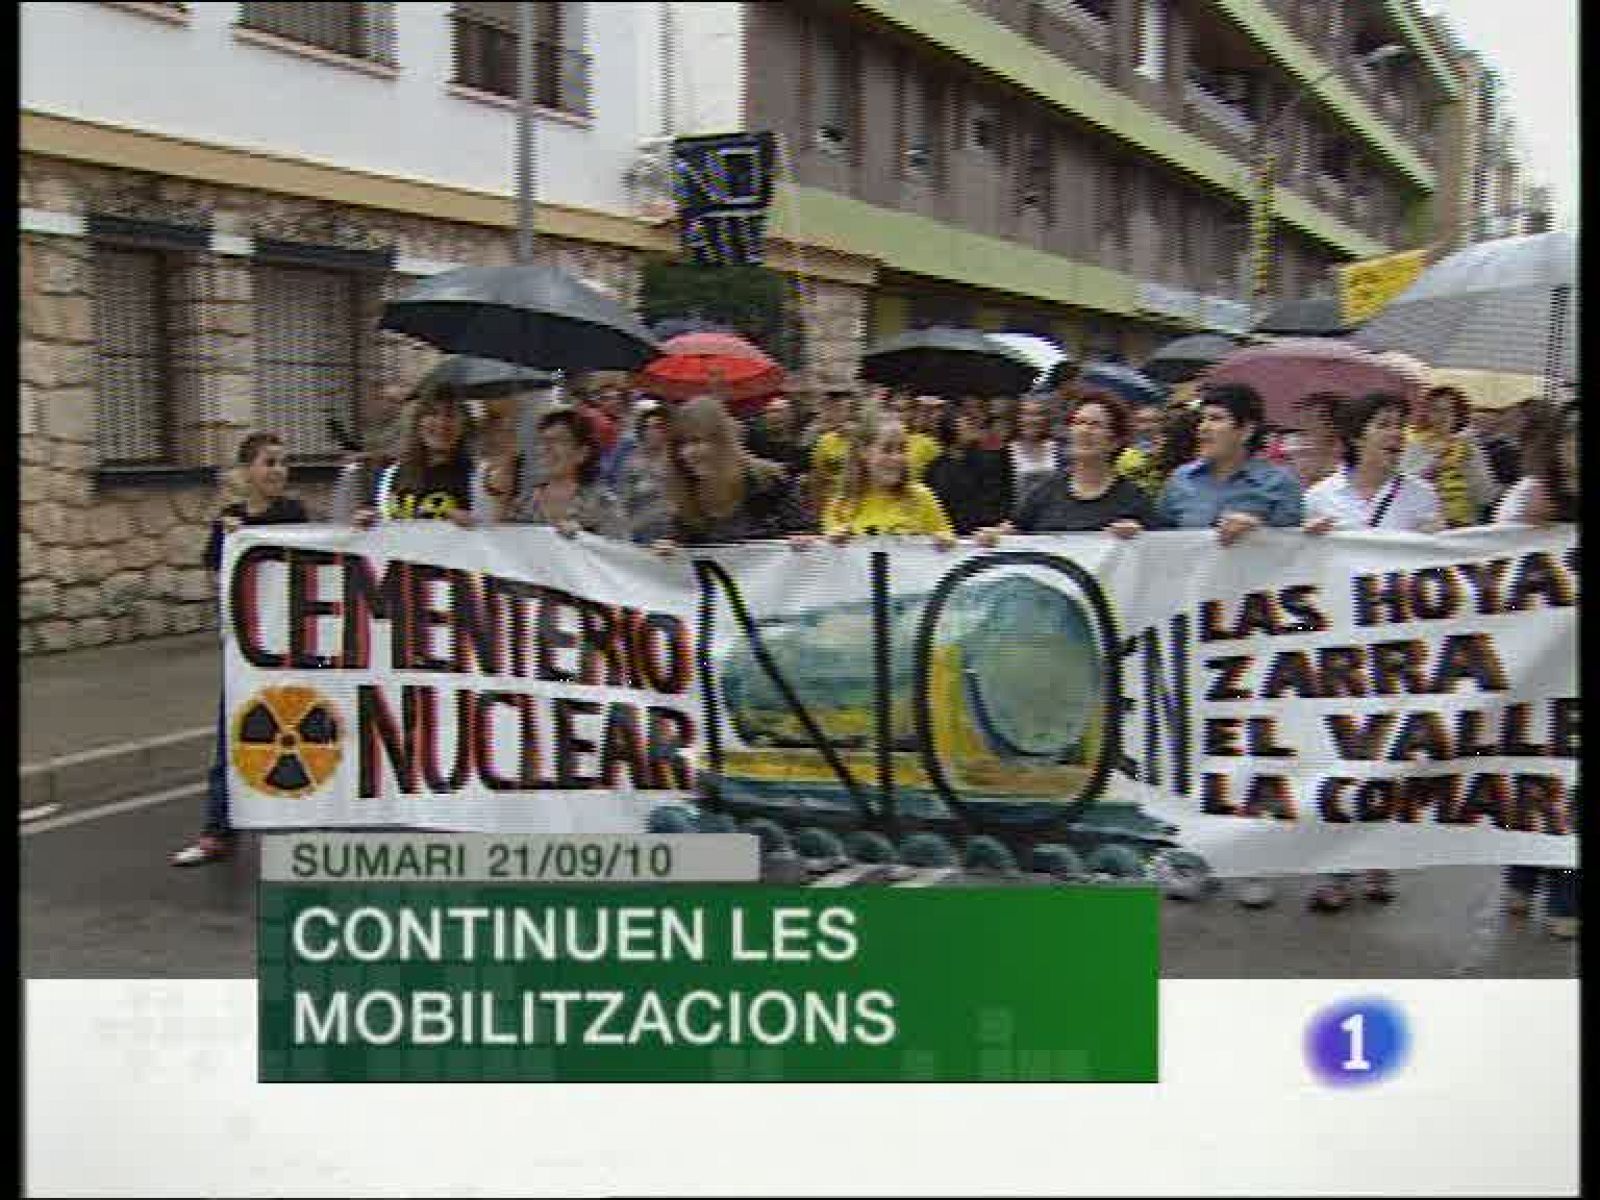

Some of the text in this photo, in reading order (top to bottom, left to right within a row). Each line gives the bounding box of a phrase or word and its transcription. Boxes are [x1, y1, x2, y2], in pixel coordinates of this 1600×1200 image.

[230, 544, 696, 695] CEMENTERIO
[1201, 583, 1332, 642] LAS
[693, 550, 1122, 826] NO
[1202, 633, 1511, 700] ZARRA
[356, 684, 698, 800] NUCLEAR
[1202, 715, 1298, 757] EL
[1202, 770, 1581, 836] LA COMAR
